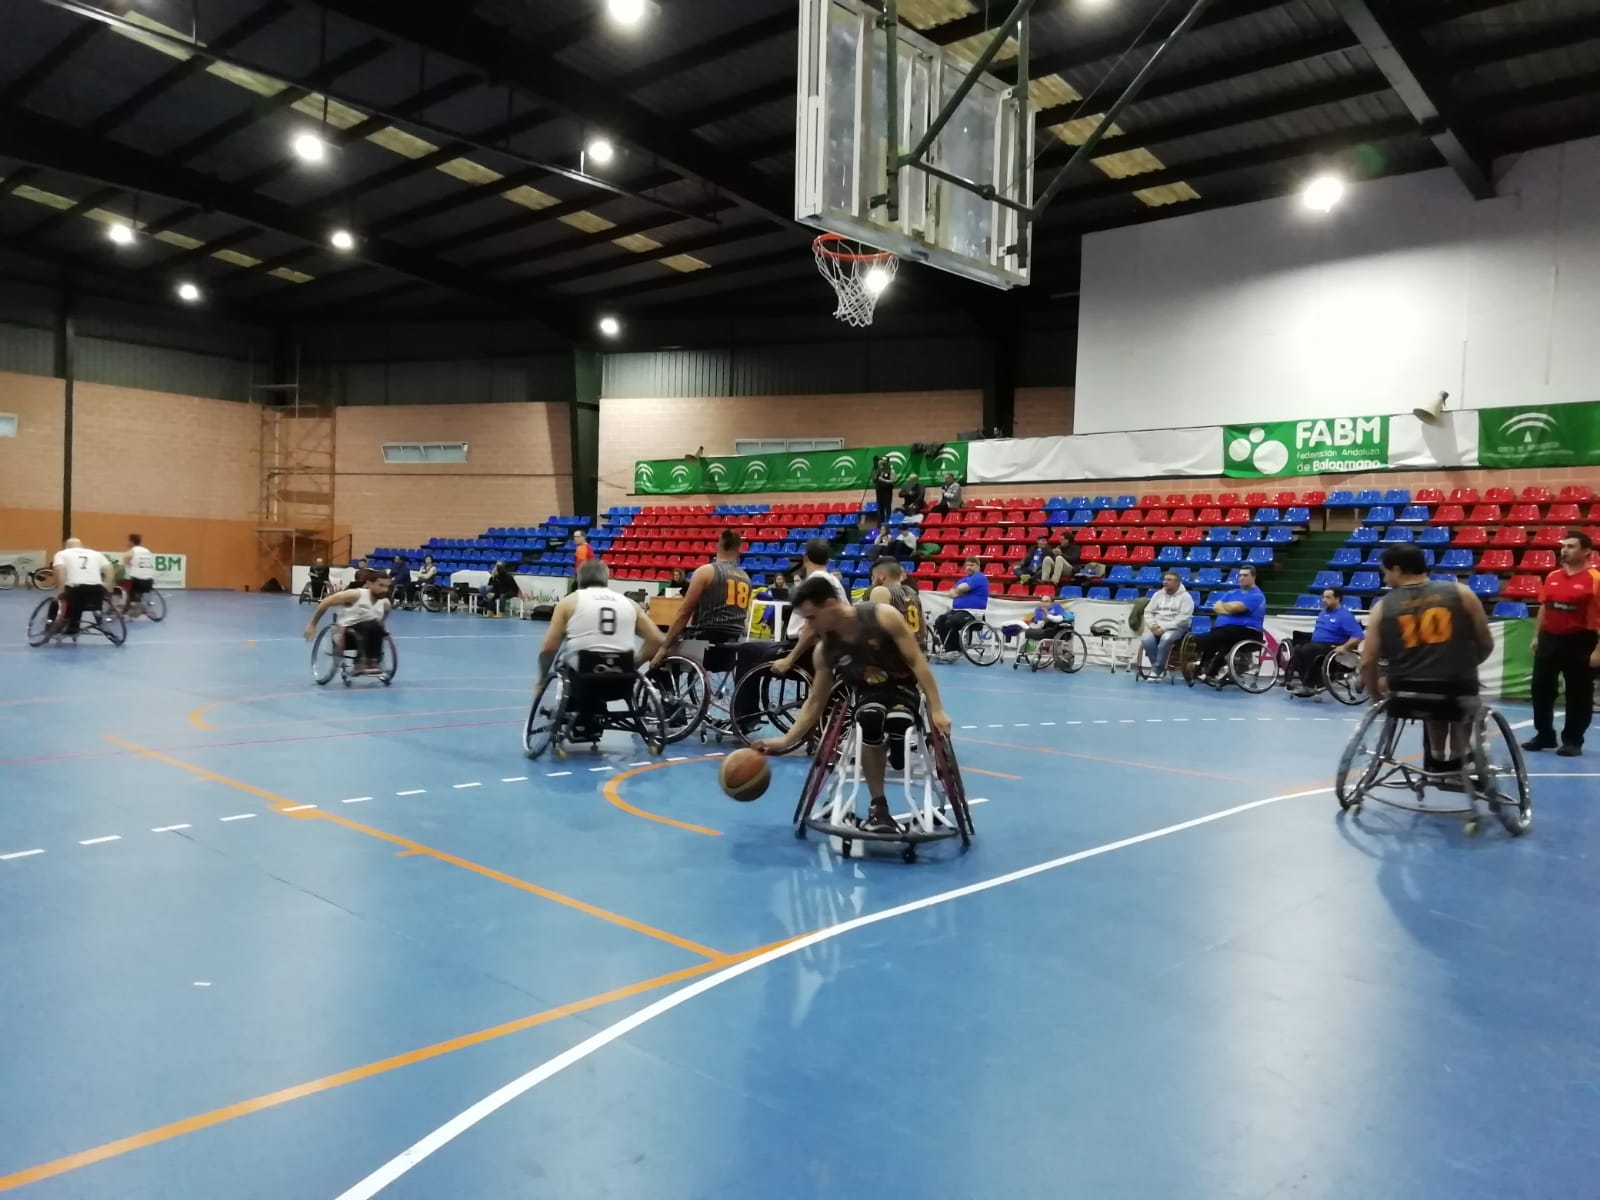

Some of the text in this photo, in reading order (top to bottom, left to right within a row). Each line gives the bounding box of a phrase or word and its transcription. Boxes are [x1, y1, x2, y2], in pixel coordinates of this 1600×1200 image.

[1295, 416, 1381, 450] FABM
[1296, 458, 1381, 473] de Balonmano
[78, 556, 89, 570] 7
[726, 578, 750, 609] 18
[599, 606, 617, 636] 8
[906, 604, 920, 633] 9
